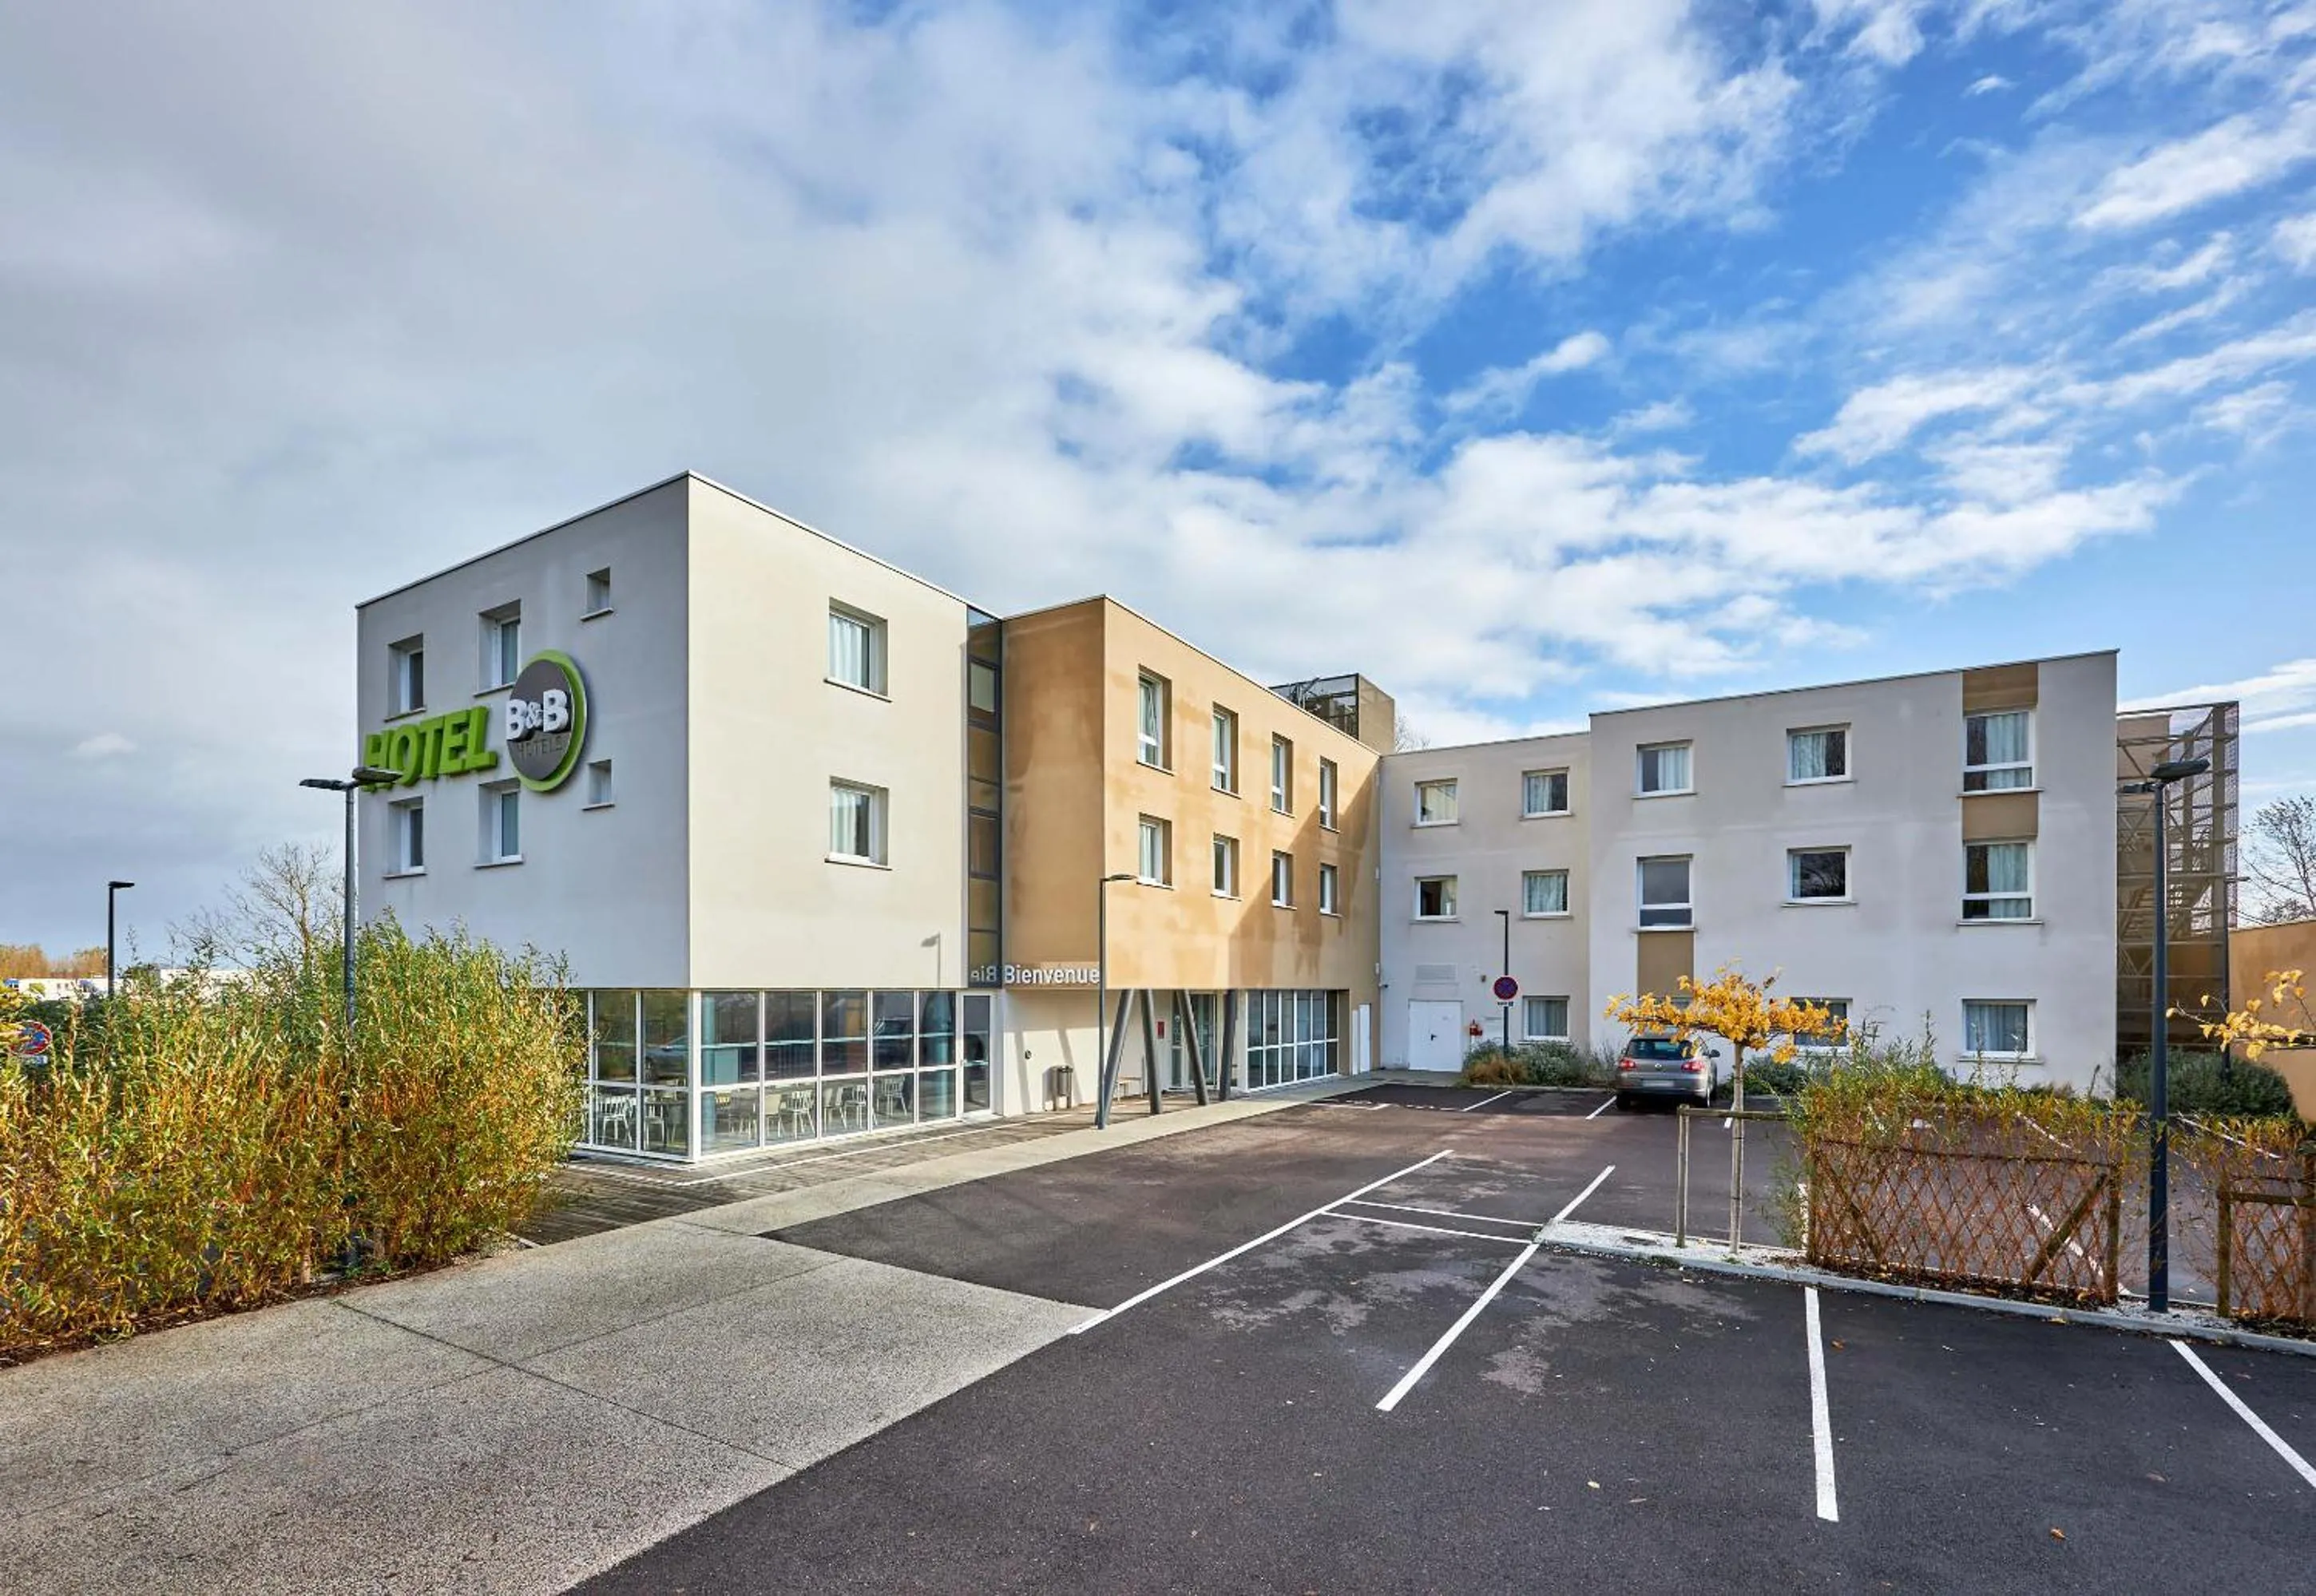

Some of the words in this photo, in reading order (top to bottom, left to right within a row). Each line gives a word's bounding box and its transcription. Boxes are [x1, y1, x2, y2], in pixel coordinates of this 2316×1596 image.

[506, 689, 569, 741] B&B
[363, 706, 498, 793] HOTEL
[1003, 964, 1100, 984] Bienvenue
